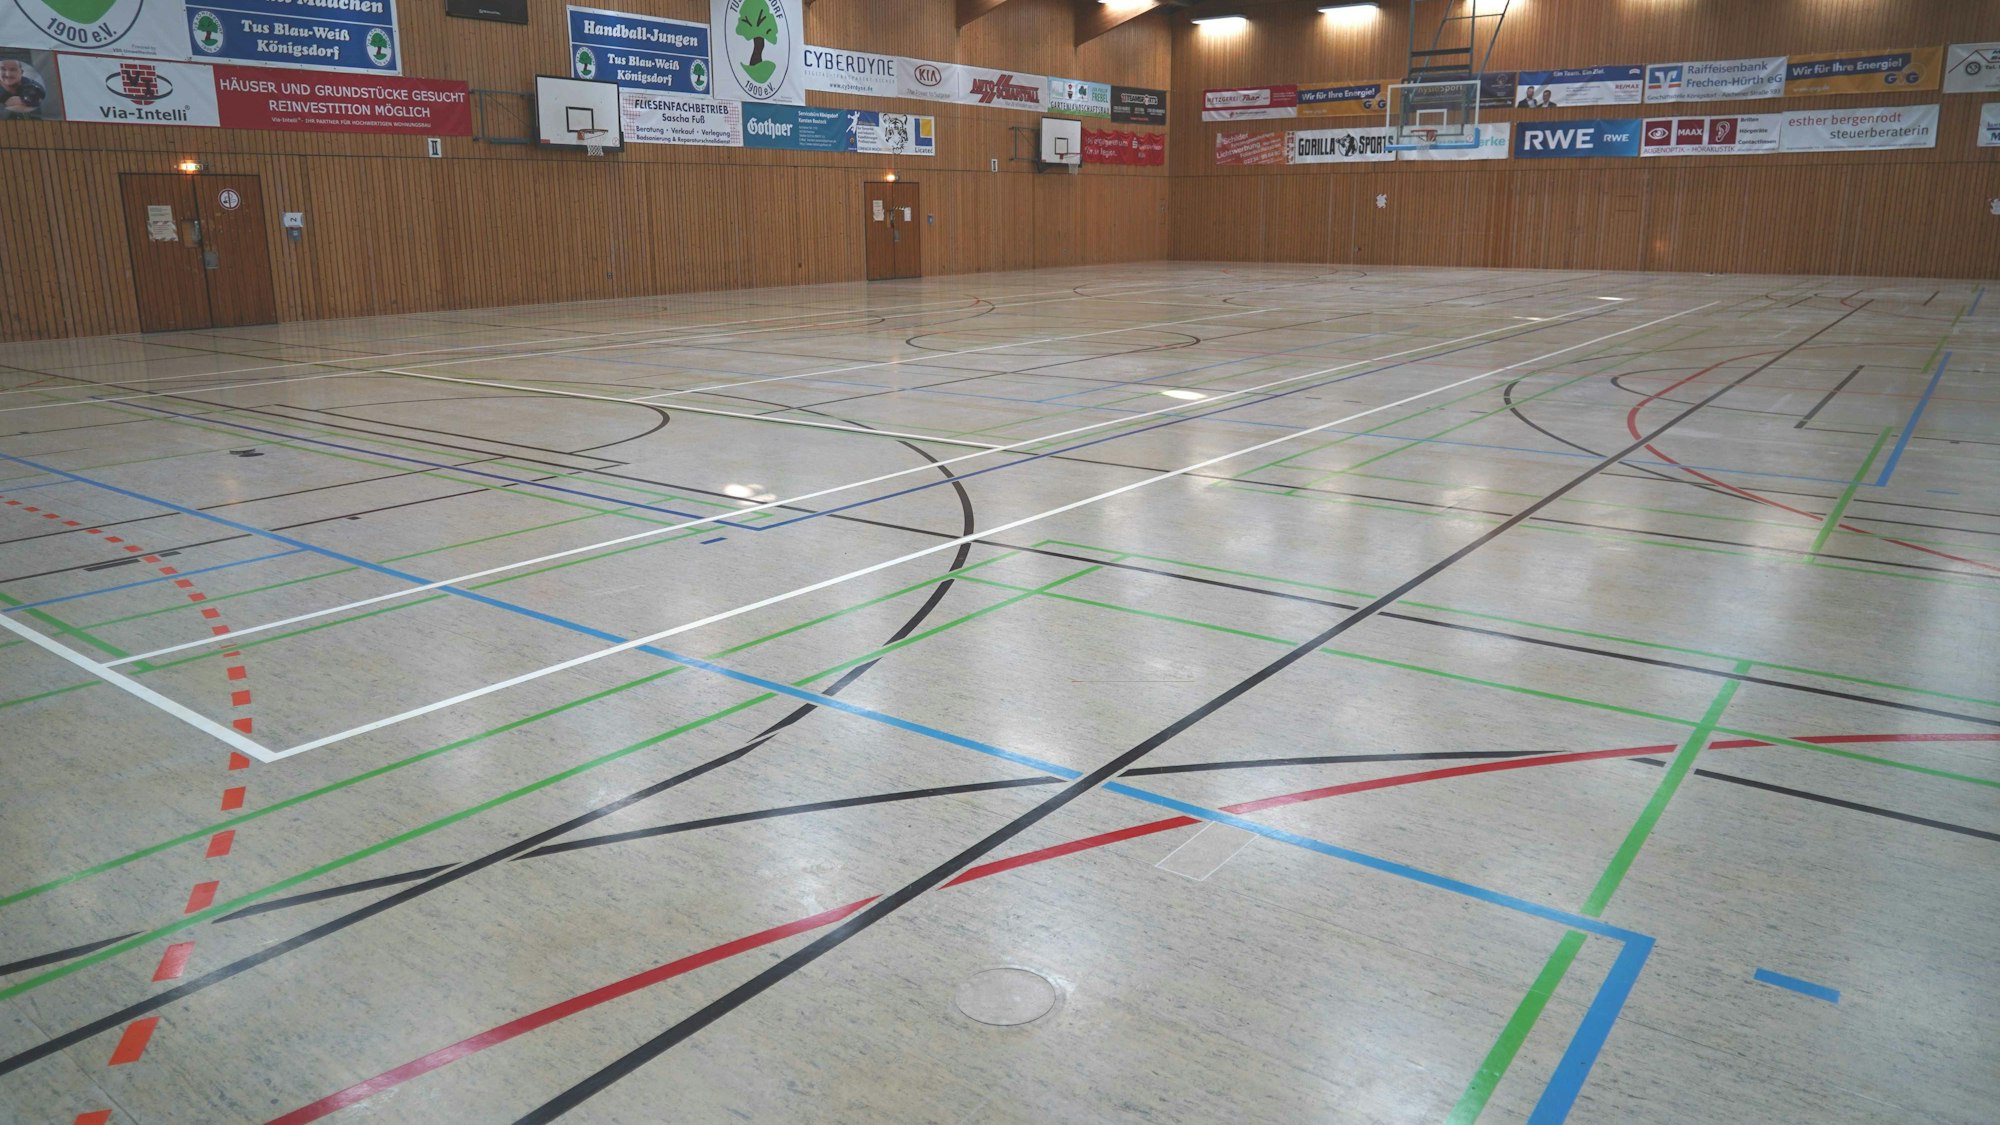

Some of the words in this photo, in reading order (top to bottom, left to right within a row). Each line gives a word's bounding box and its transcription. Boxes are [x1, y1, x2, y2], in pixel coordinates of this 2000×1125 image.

[47, 17, 88, 44] 1900
[93, 22, 118, 43] e.V.
[241, 19, 270, 34] Tus
[274, 22, 350, 41] Blau-Weiß
[583, 20, 698, 48] Handball-Jungen
[257, 39, 340, 60] Königsdorf
[607, 53, 626, 65] Tus
[628, 55, 680, 71] Blau-Weiß
[804, 49, 895, 77] CYBERDYNE
[1687, 61, 1768, 75] Raiffeisenbank
[1792, 66, 1813, 76] Wir
[1814, 64, 1831, 74] für
[1832, 62, 1855, 72] Ihre
[1856, 58, 1902, 71] Energie!
[617, 69, 672, 87] Königsdorf
[918, 68, 938, 83] KIA
[1686, 75, 1764, 88] Frechen-Hürth
[1767, 73, 1782, 84] eG
[220, 77, 278, 94] HÄUSER
[281, 83, 310, 96] UND
[315, 84, 408, 101] GRUNDSTÜCKE
[412, 90, 465, 103] GESUCHT
[744, 80, 762, 97] 1900
[764, 82, 776, 96] e.V.
[1302, 92, 1315, 100] Wir
[1316, 91, 1327, 99] für
[1328, 90, 1343, 98] Ihre
[1344, 88, 1375, 98] Energie!
[269, 99, 371, 116] REINVESTITION
[375, 103, 430, 118] MÖGLICH
[634, 99, 729, 114] FLIESENFACHBETRIEB
[662, 113, 690, 123] Sascha
[691, 116, 705, 124] Fuß
[1788, 115, 1828, 127] esther
[1831, 112, 1902, 127] bergenrodt
[636, 125, 664, 135] Beratung
[670, 127, 694, 135] Verkauf
[701, 129, 731, 139] Verlegung
[747, 117, 793, 139] Gothaer
[1677, 128, 1703, 137] MAAX
[1830, 125, 1929, 139] steuerberaterin
[1298, 137, 1336, 157] GORILLA
[1358, 135, 1394, 156] SPORTS
[1524, 127, 1595, 150] RWE
[1603, 133, 1630, 142] RWE
[1643, 146, 1685, 154] AUGENOPTIK
[1691, 145, 1735, 153] HÖRAKUSTIK
